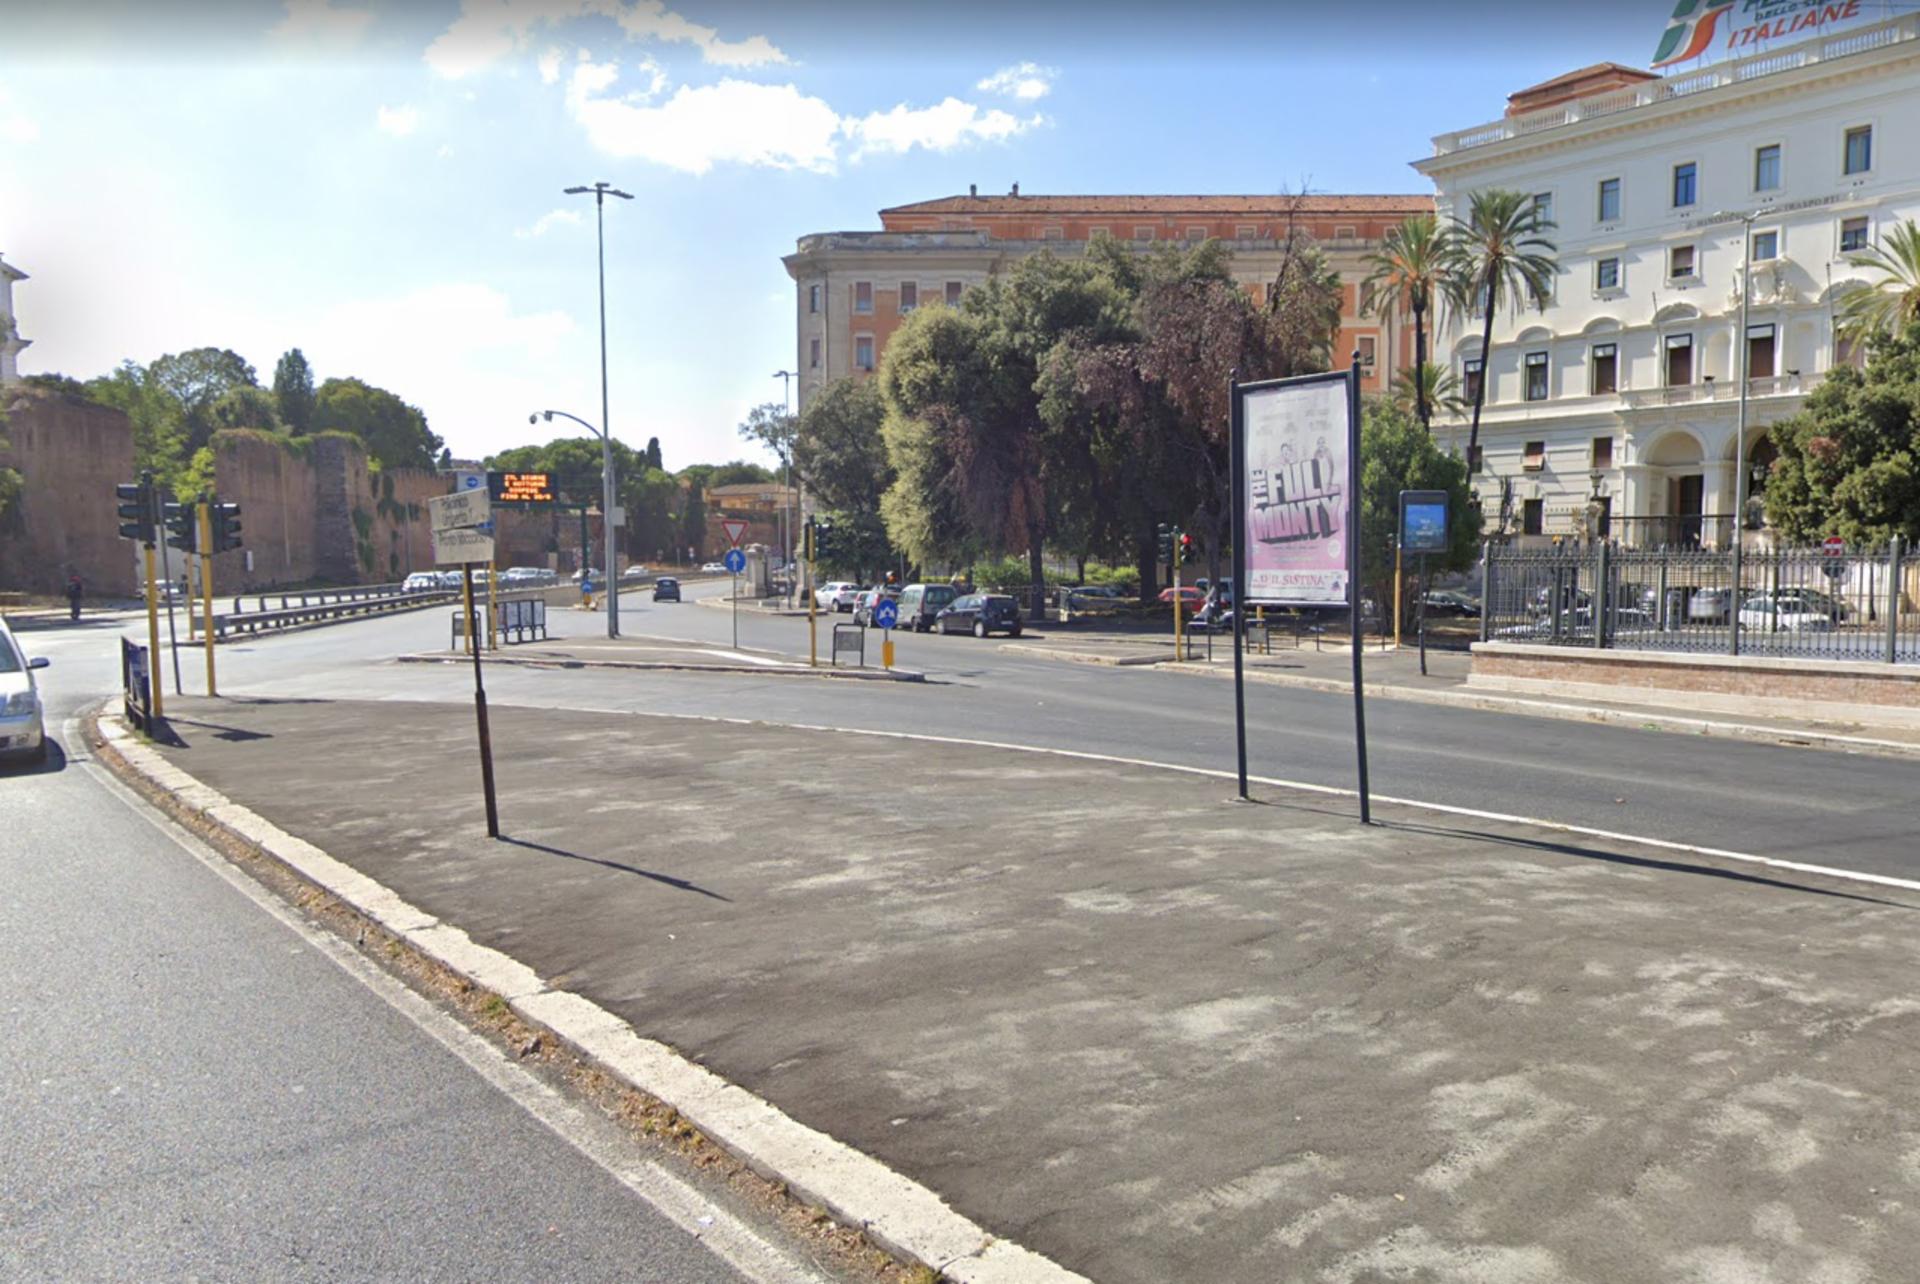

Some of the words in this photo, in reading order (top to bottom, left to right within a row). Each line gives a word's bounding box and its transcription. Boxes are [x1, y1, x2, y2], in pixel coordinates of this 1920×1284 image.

[1727, 0, 1860, 49] ITALIANE
[1251, 469, 1268, 509] THE
[1266, 457, 1341, 506] FULL
[1253, 494, 1341, 544] MONTY
